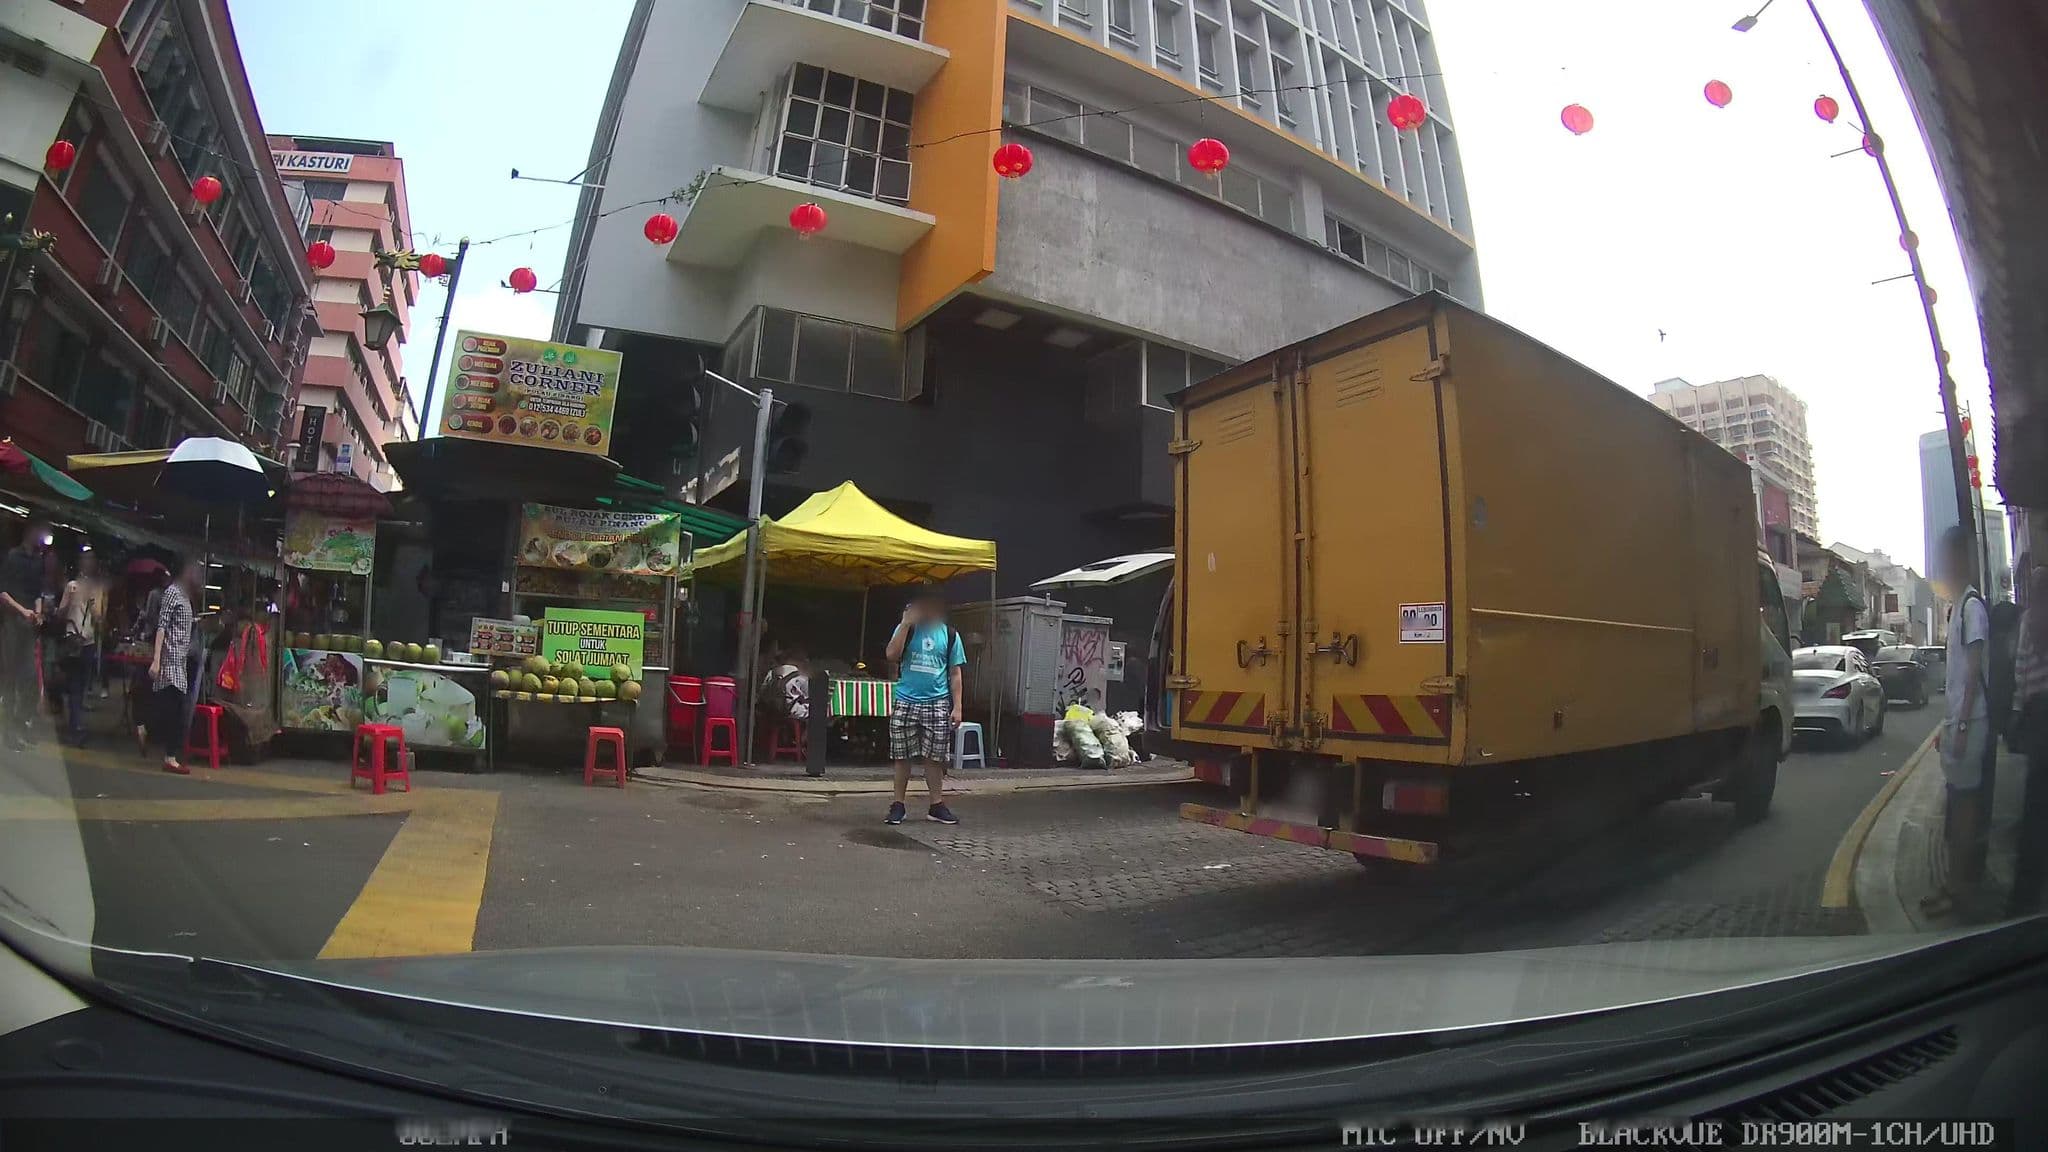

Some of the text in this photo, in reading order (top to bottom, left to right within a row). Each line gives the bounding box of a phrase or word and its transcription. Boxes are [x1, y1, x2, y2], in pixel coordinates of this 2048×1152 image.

[287, 154, 350, 170] KASTURI
[510, 360, 605, 383] ZULIANI
[510, 373, 600, 396] CORNER
[303, 417, 317, 462] HOTEL
[547, 620, 640, 639] TUTUP SEMENTARA
[580, 638, 606, 650] UNTUK
[556, 650, 630, 667] SOLAT JUMAAT
